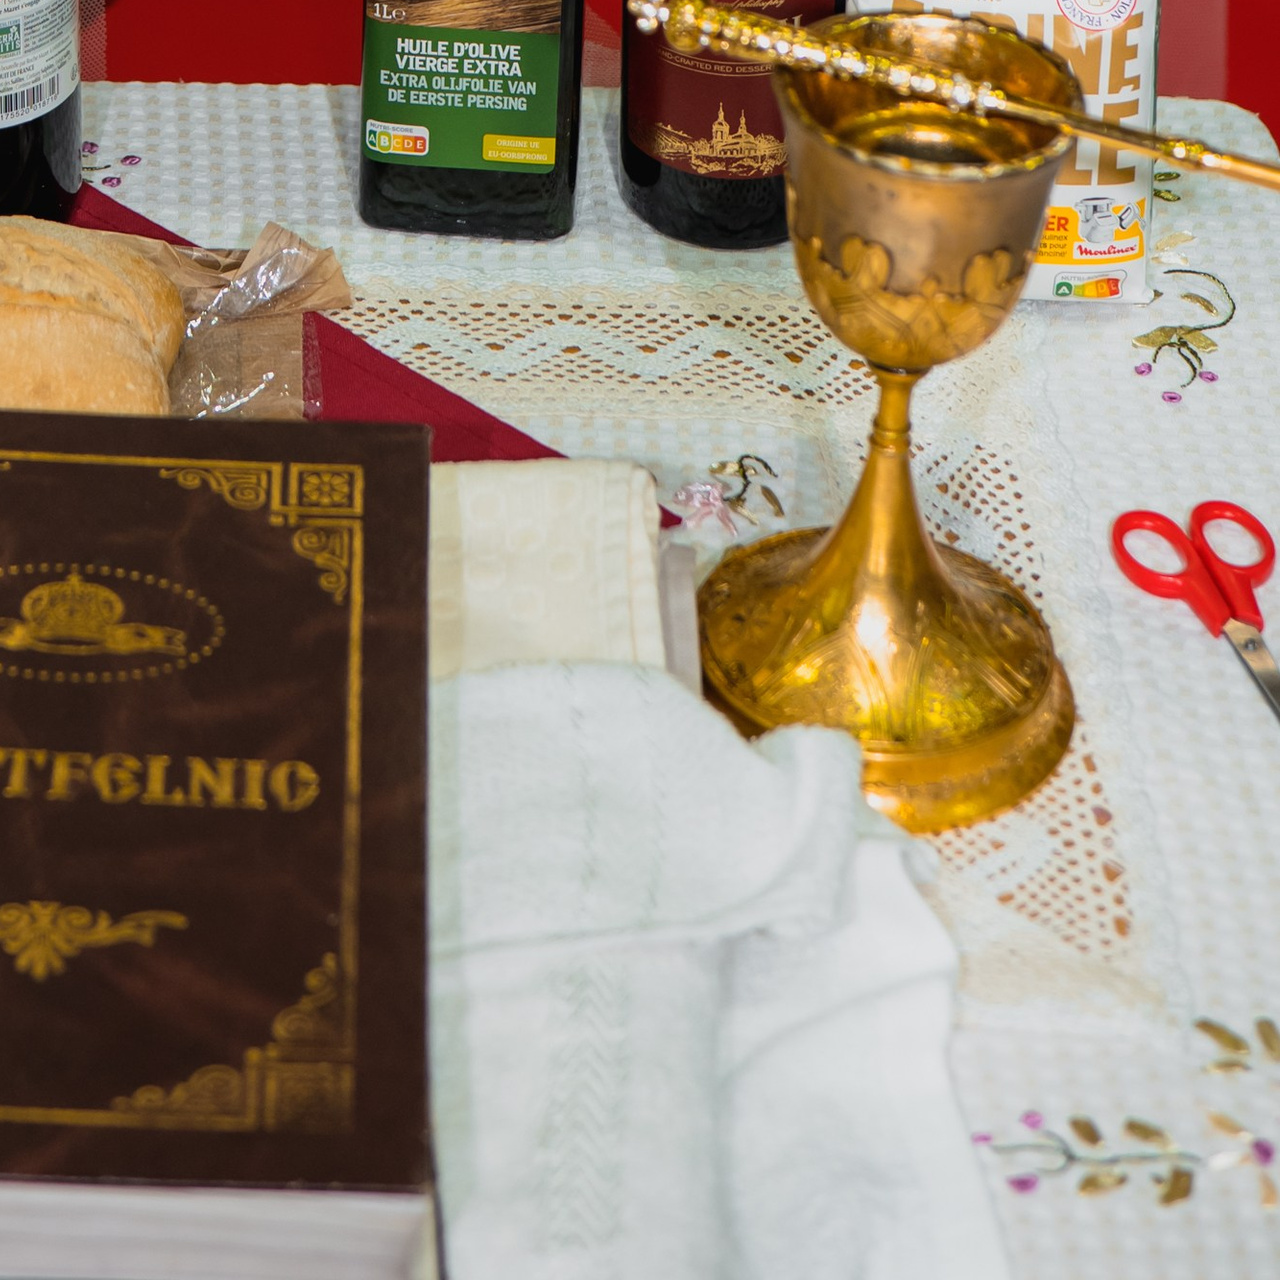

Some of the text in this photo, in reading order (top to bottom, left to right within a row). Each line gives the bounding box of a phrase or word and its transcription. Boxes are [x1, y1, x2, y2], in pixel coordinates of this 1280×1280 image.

[397, 38, 449, 56] HUILE
[395, 54, 522, 77] VIERGE EXTRA
[713, 64, 733, 73] RED
[735, 64, 773, 74] DESSER
[380, 70, 536, 95] EXTRA OLIJFOLIE VAN
[388, 89, 527, 111] DE EERSTE PERSING
[370, 122, 414, 133] NUTRI-SCORE
[496, 139, 528, 148] ORIGINE
[1077, 244, 1136, 256] Moulinex
